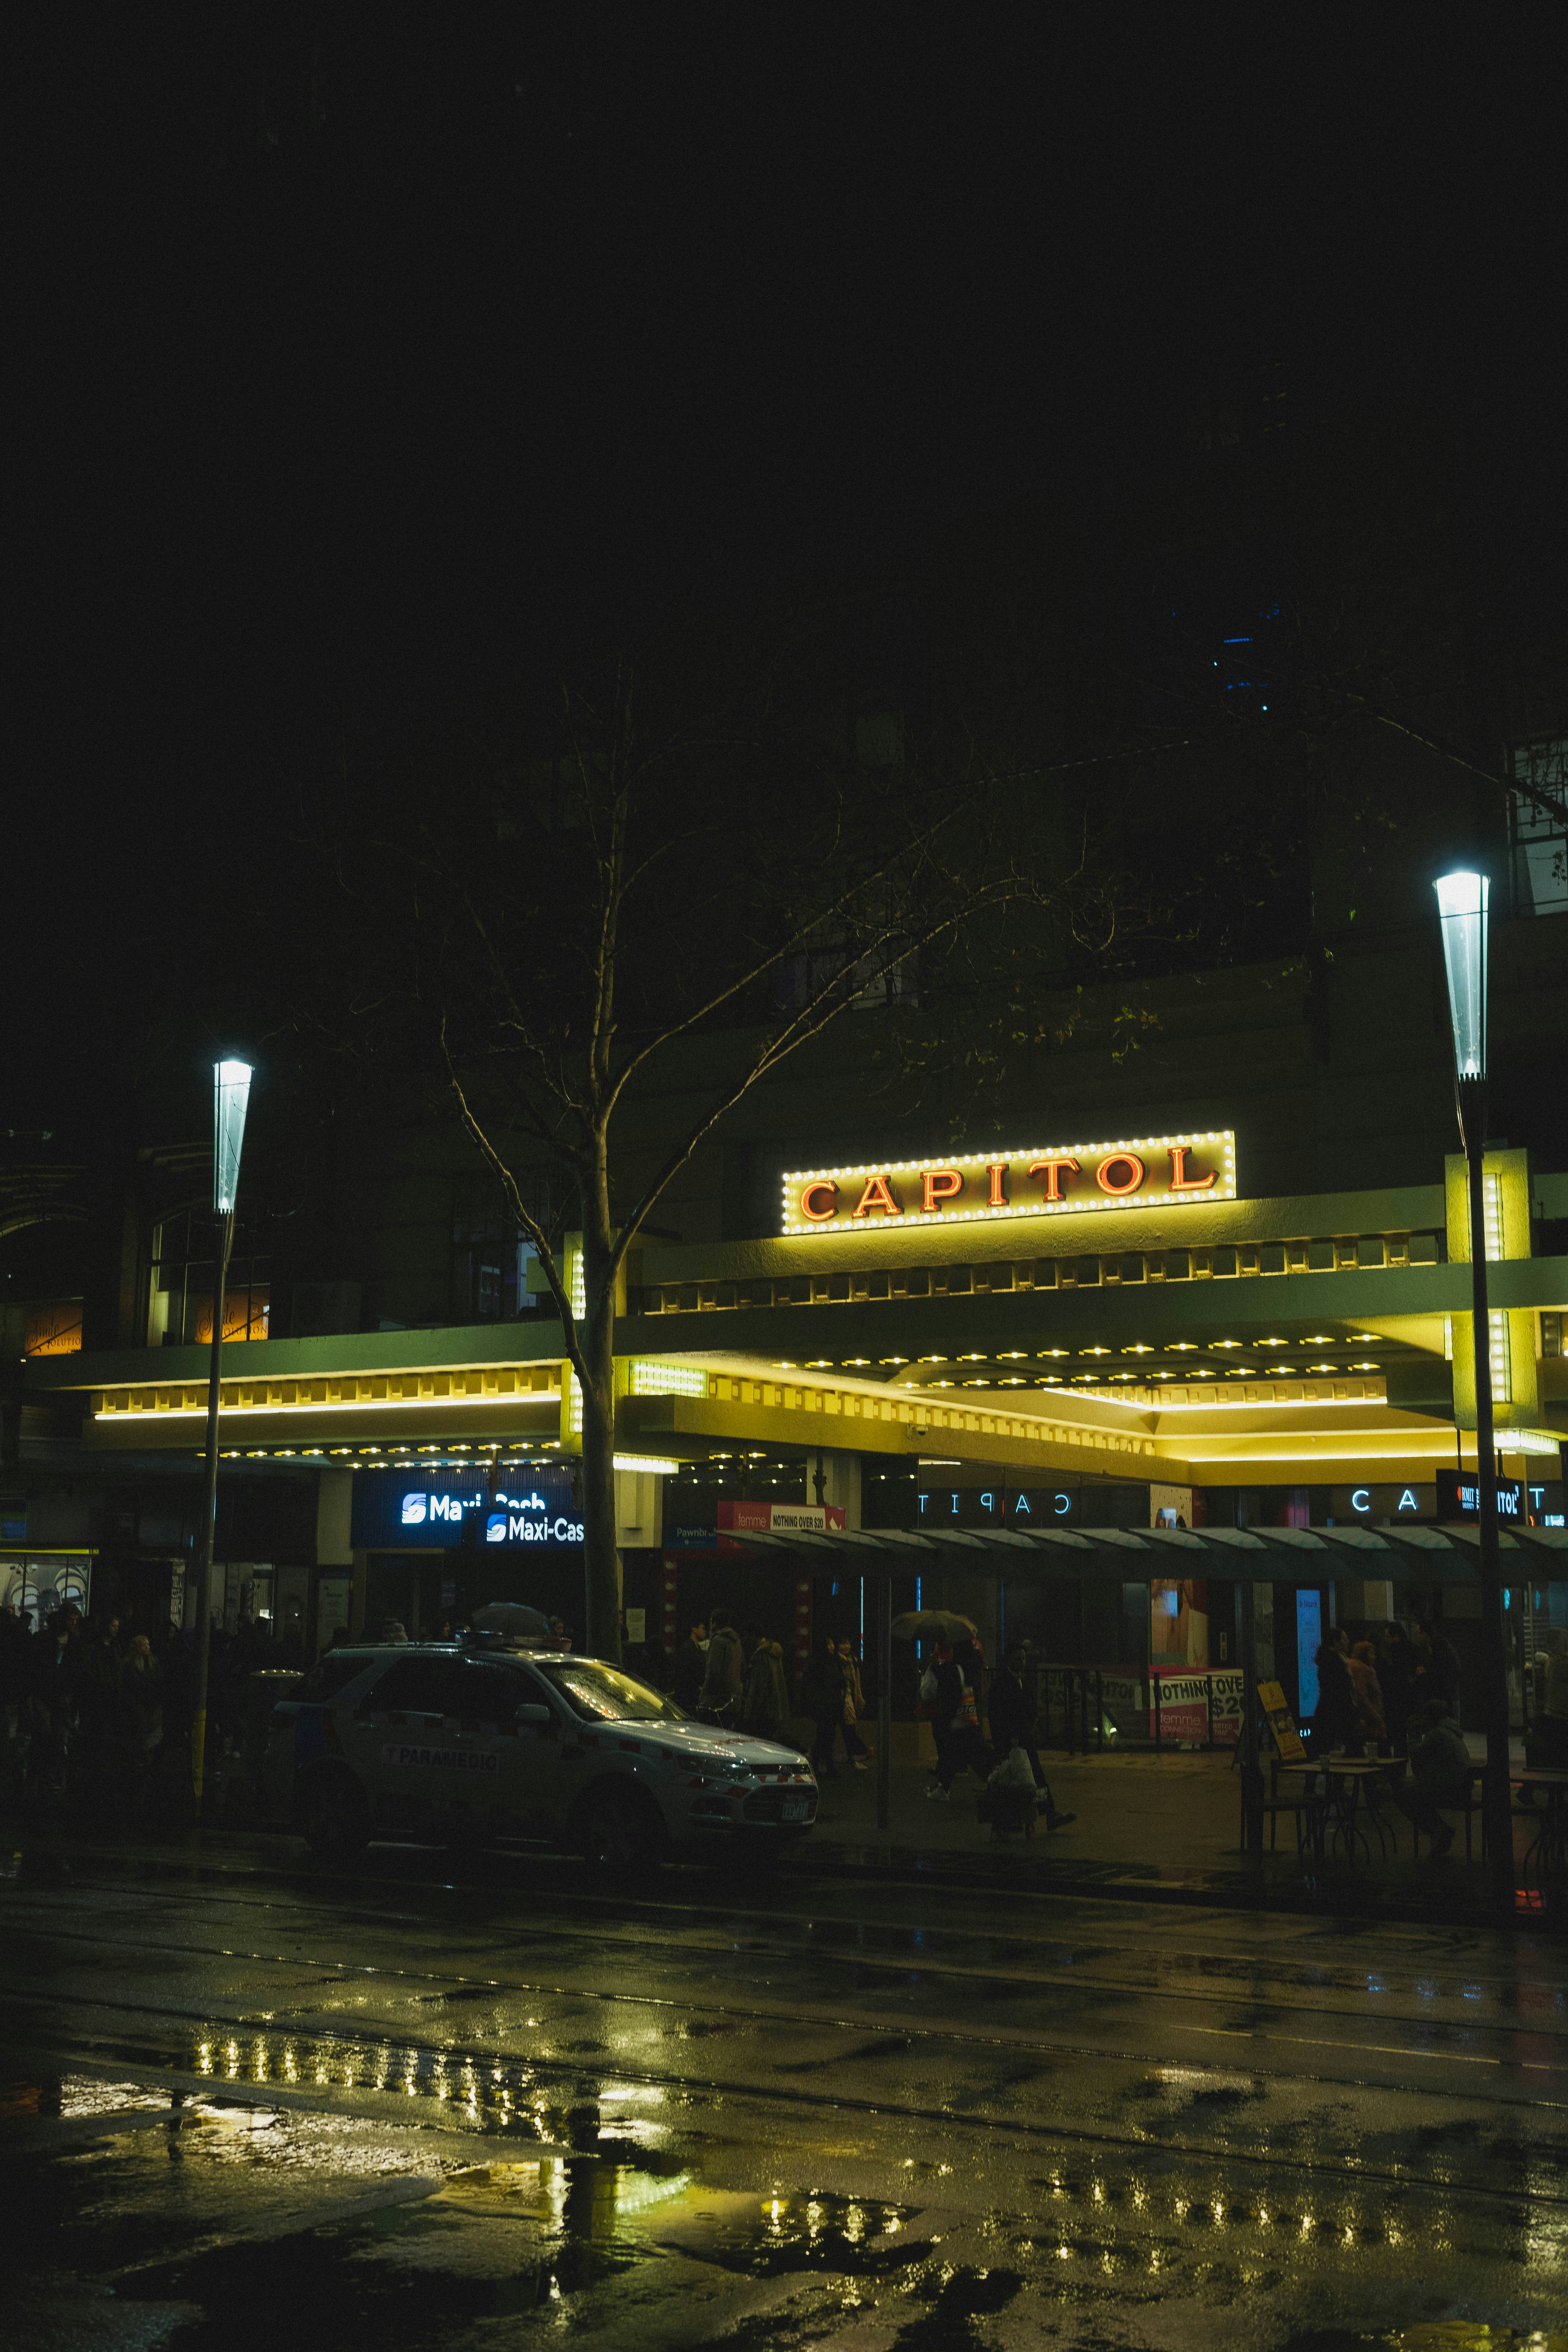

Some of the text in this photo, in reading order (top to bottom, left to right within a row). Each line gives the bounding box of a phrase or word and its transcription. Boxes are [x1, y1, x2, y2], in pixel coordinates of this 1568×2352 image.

[800, 1146, 1220, 1221] CAPITOL
[1461, 1486, 1474, 1502] RMIT
[738, 1513, 766, 1528] femme
[773, 1515, 823, 1530] NOTHING OVER $20
[1212, 1697, 1244, 1718] $2
[1160, 1712, 1201, 1726] femme
[399, 1748, 497, 1769] PARAMEDIC
